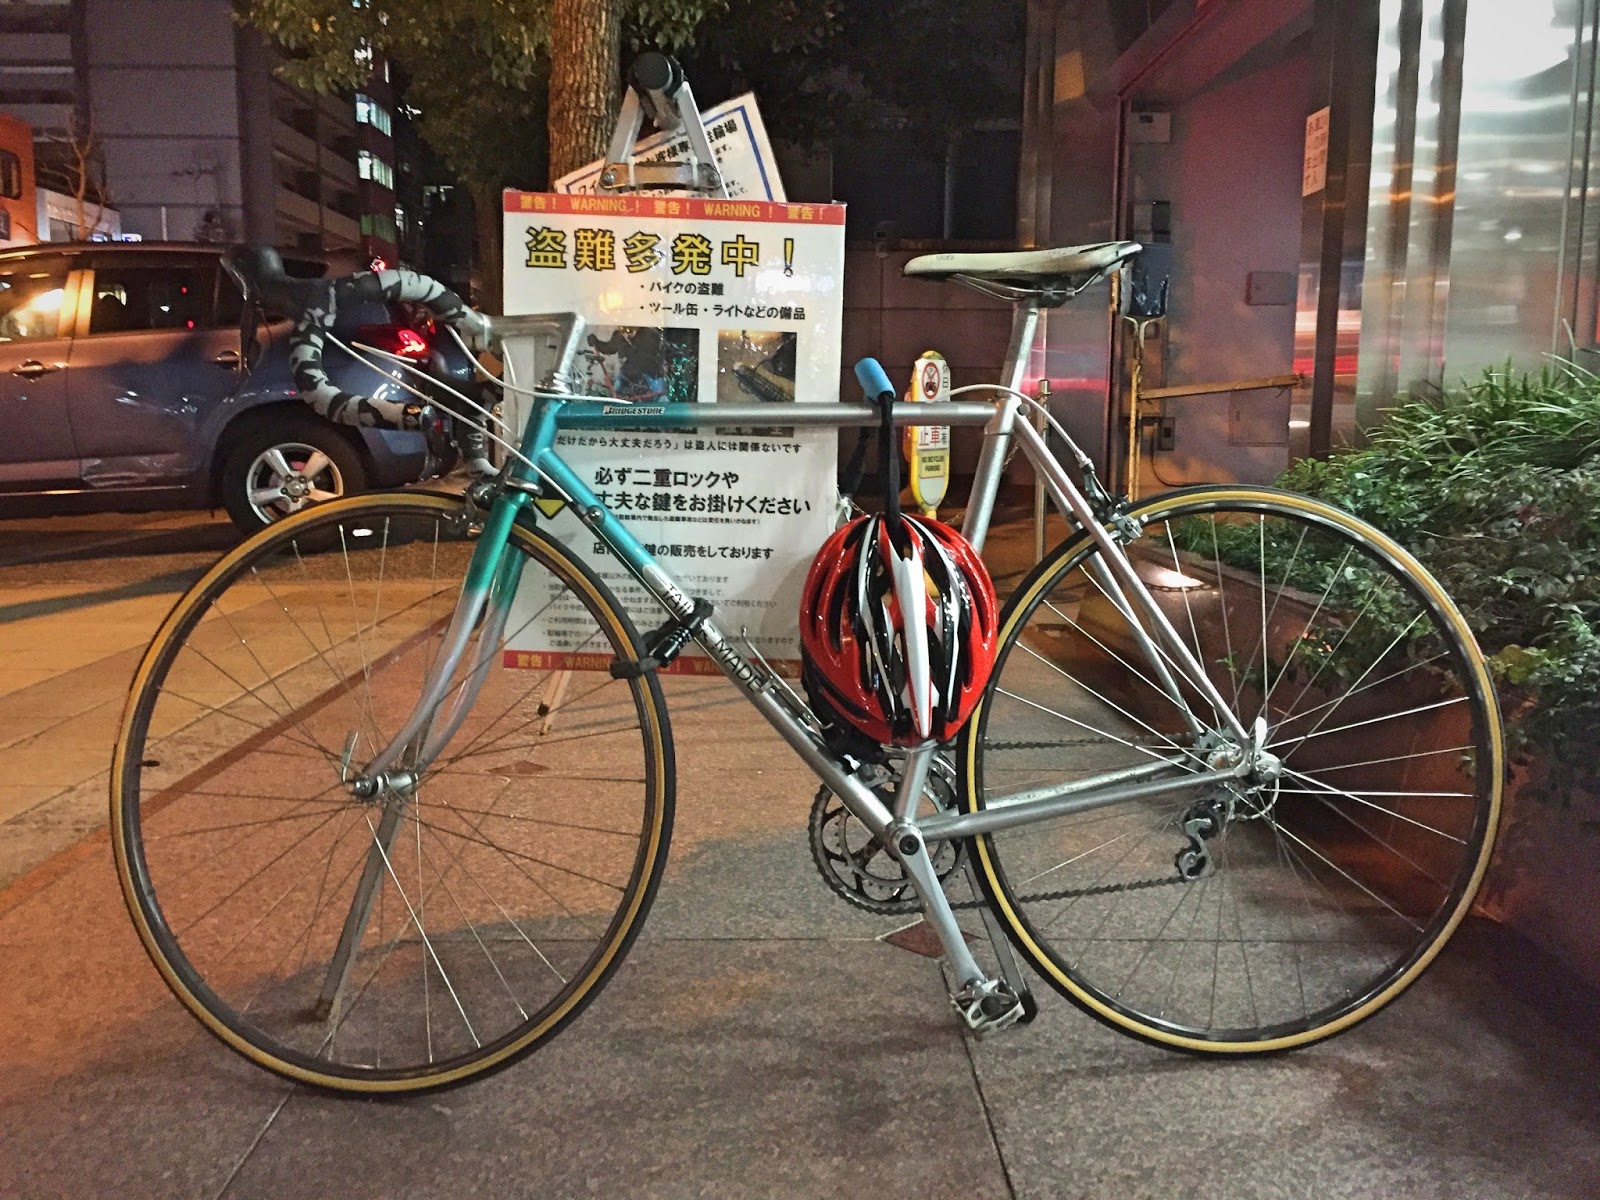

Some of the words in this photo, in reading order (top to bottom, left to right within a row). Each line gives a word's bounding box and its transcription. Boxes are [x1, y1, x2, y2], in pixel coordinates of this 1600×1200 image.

[570, 197, 626, 212] WARNING
[704, 203, 760, 218] WARNING
[525, 226, 794, 277] 盗難多発中！
[604, 406, 665, 415] BRIDGESTONE
[595, 467, 739, 489] 必ず二重ロックや
[595, 491, 811, 515] 丈夫な鍵をお掛けください
[561, 656, 609, 670] WARNIN
